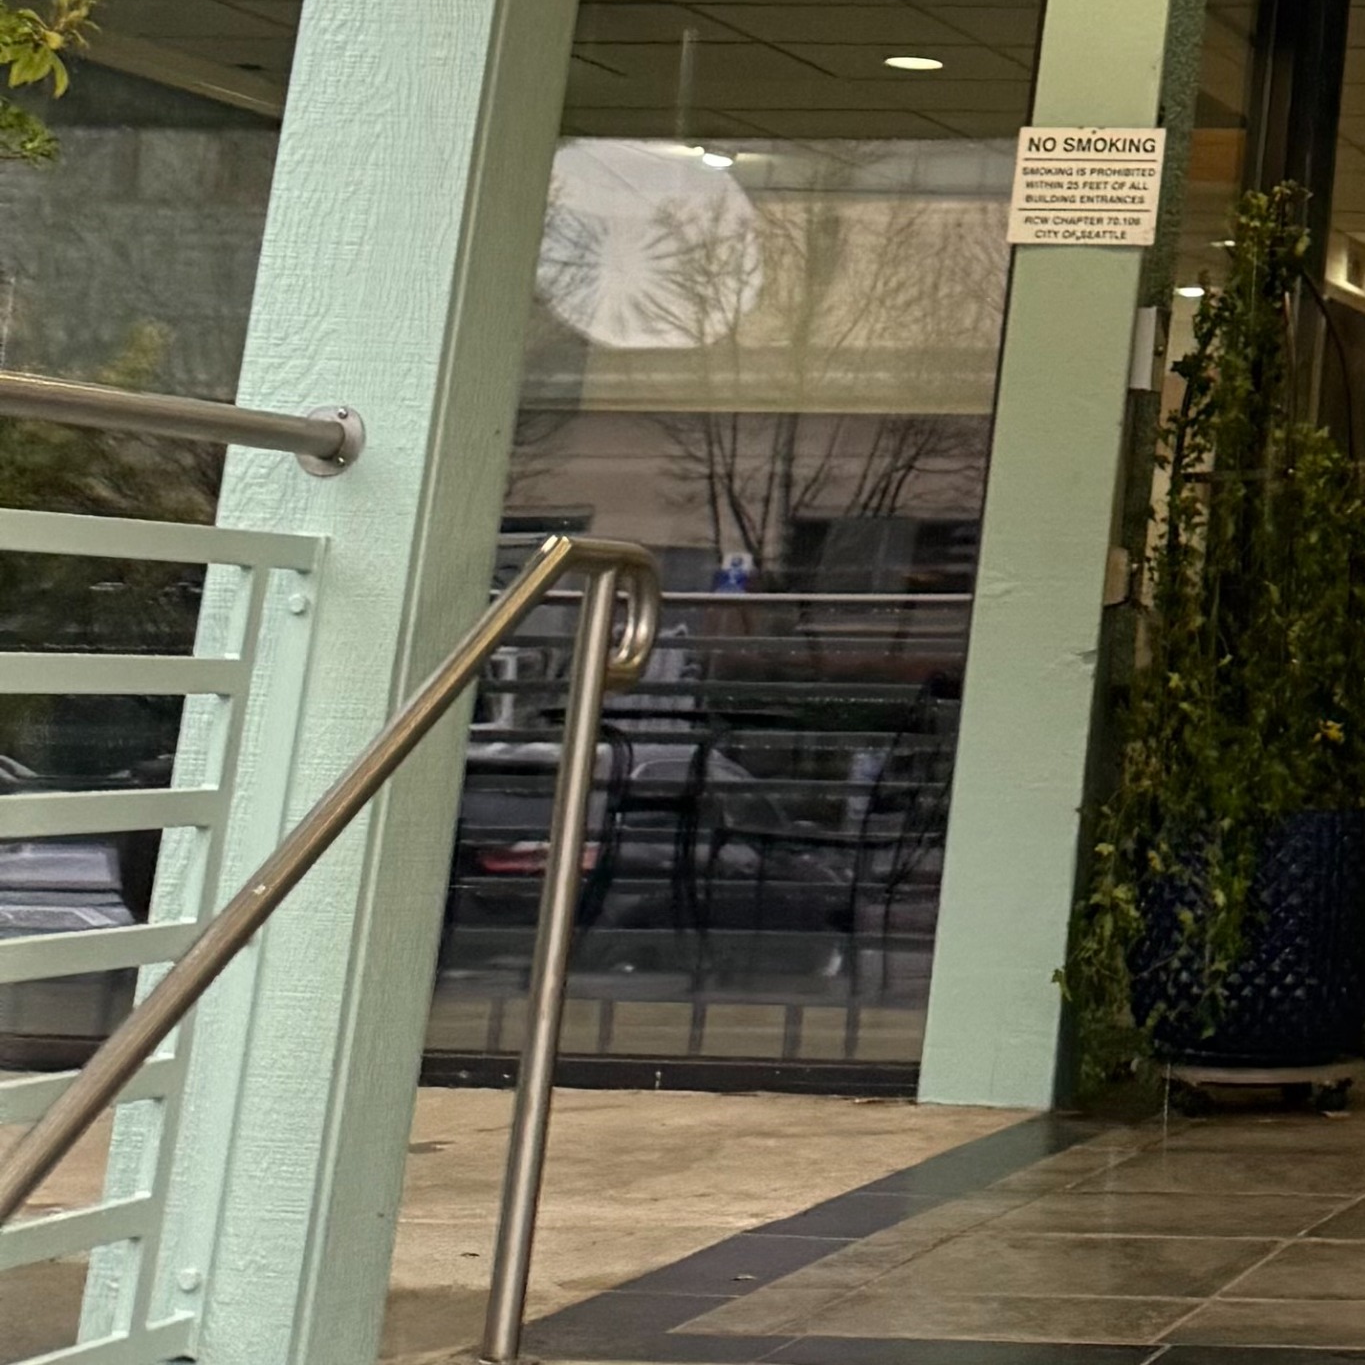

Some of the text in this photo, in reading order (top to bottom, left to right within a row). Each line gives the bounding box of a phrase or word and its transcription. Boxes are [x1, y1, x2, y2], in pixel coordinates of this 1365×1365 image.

[1027, 137, 1156, 153] NO SMOKING
[1022, 167, 1156, 177] SMOKING IS PROHIBITED
[1025, 181, 1149, 191] WITHIN 25 FEET OF ALL
[1025, 194, 1146, 205] BUILDING ENTRANCES
[1024, 216, 1049, 225] RCW
[1052, 216, 1104, 226] CHAPTER
[1034, 229, 1127, 240] CITY OF SEATTLE
